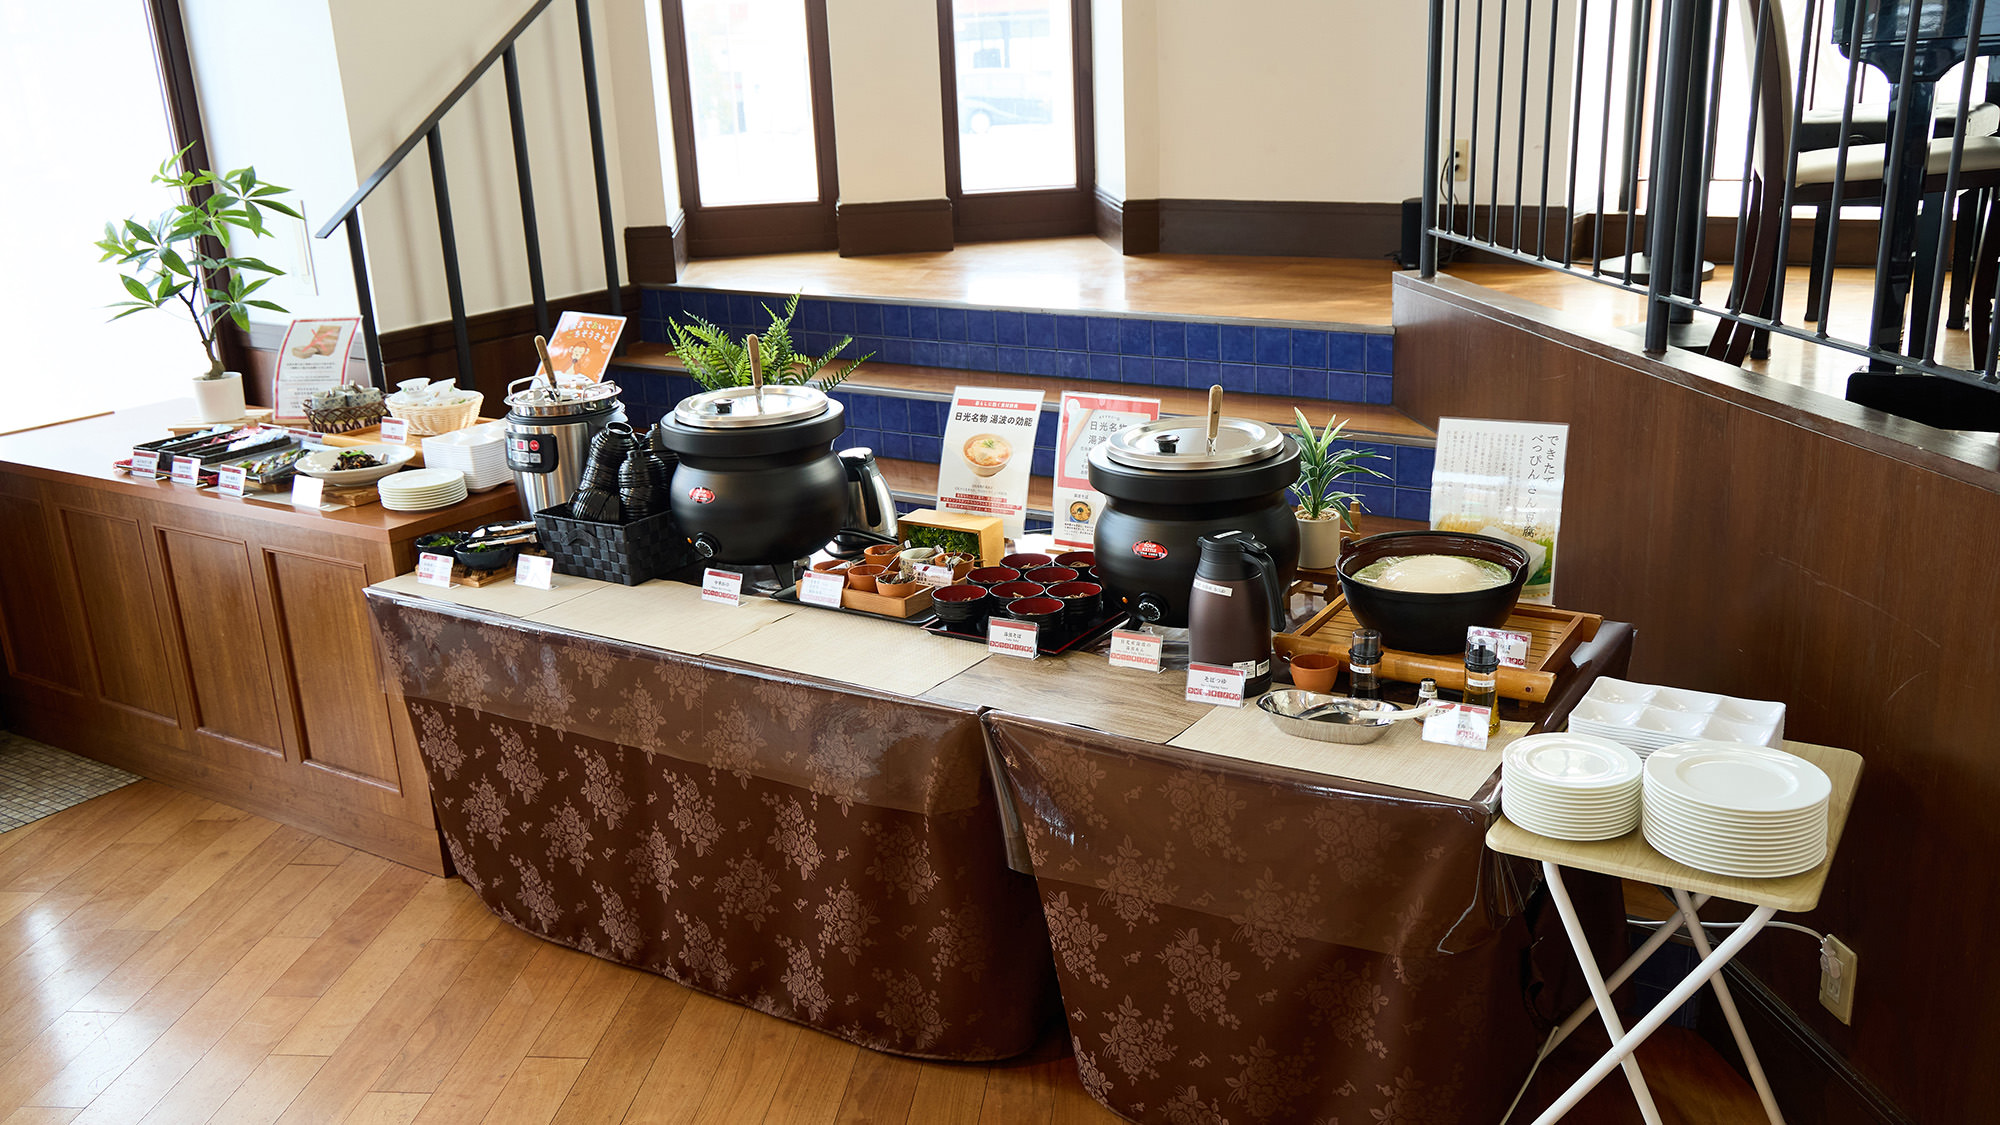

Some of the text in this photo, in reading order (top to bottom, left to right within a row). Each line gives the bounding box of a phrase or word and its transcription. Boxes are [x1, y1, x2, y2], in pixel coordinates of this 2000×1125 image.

[955, 411, 1033, 427] 日光名物 湯波の効能
[1521, 434, 1545, 538] べっぴんさん豆腐
[1543, 434, 1560, 486] できたて
